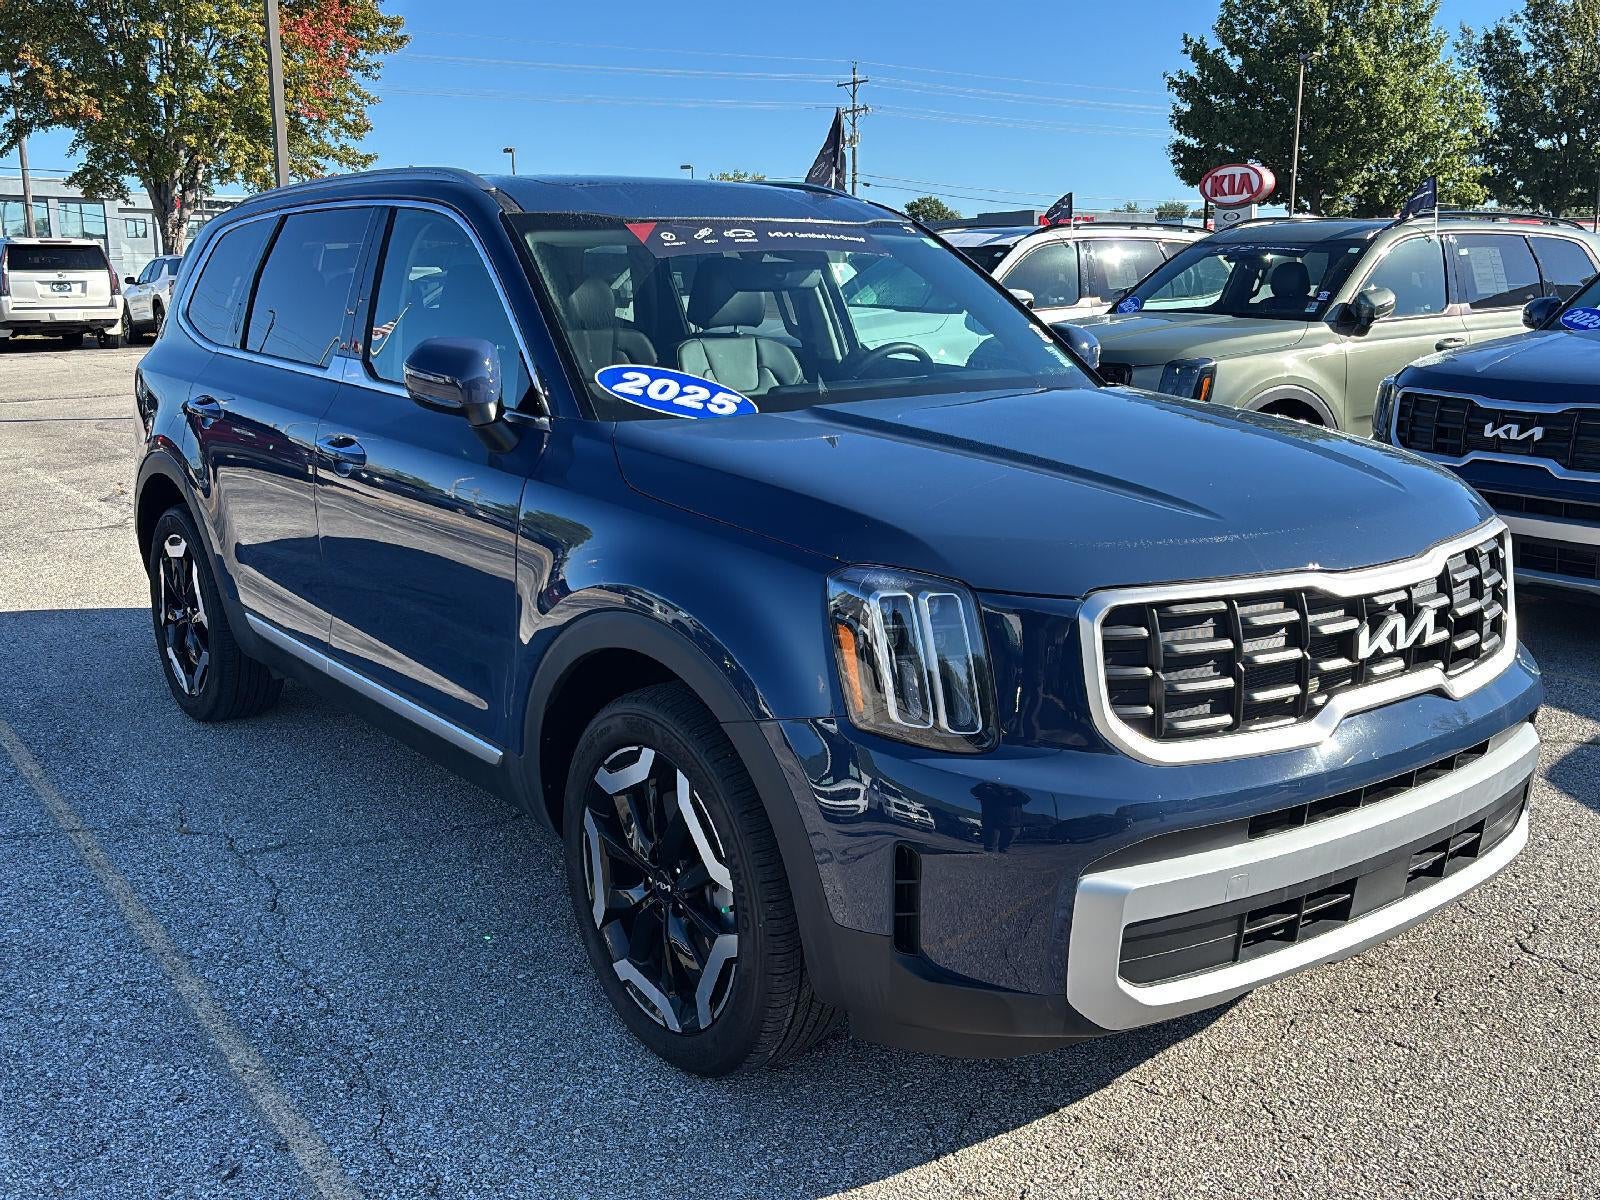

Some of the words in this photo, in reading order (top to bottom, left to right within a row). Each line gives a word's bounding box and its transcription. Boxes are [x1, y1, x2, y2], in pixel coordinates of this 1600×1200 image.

[1209, 173, 1254, 197] KIA
[611, 371, 743, 416] 2025
[1484, 422, 1544, 442] KIA
[1355, 605, 1436, 660] KIA
